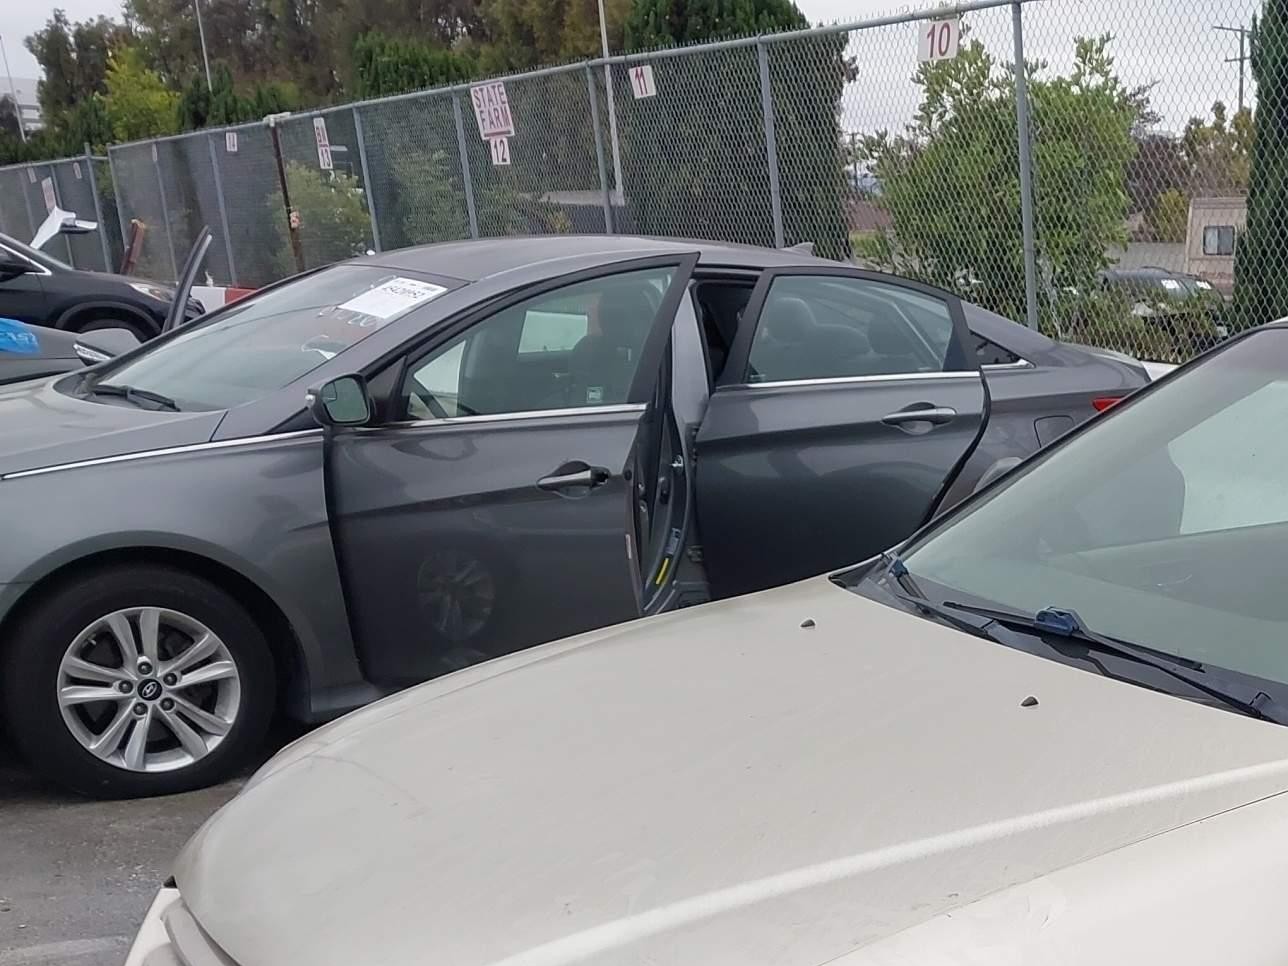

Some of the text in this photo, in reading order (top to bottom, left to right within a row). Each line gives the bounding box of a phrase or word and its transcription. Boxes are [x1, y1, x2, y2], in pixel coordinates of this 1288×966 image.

[927, 22, 951, 58] 10
[634, 66, 649, 96] 11
[472, 84, 507, 108] STATE
[479, 105, 511, 131] FARM
[320, 148, 331, 168] 13
[493, 139, 507, 163] 12
